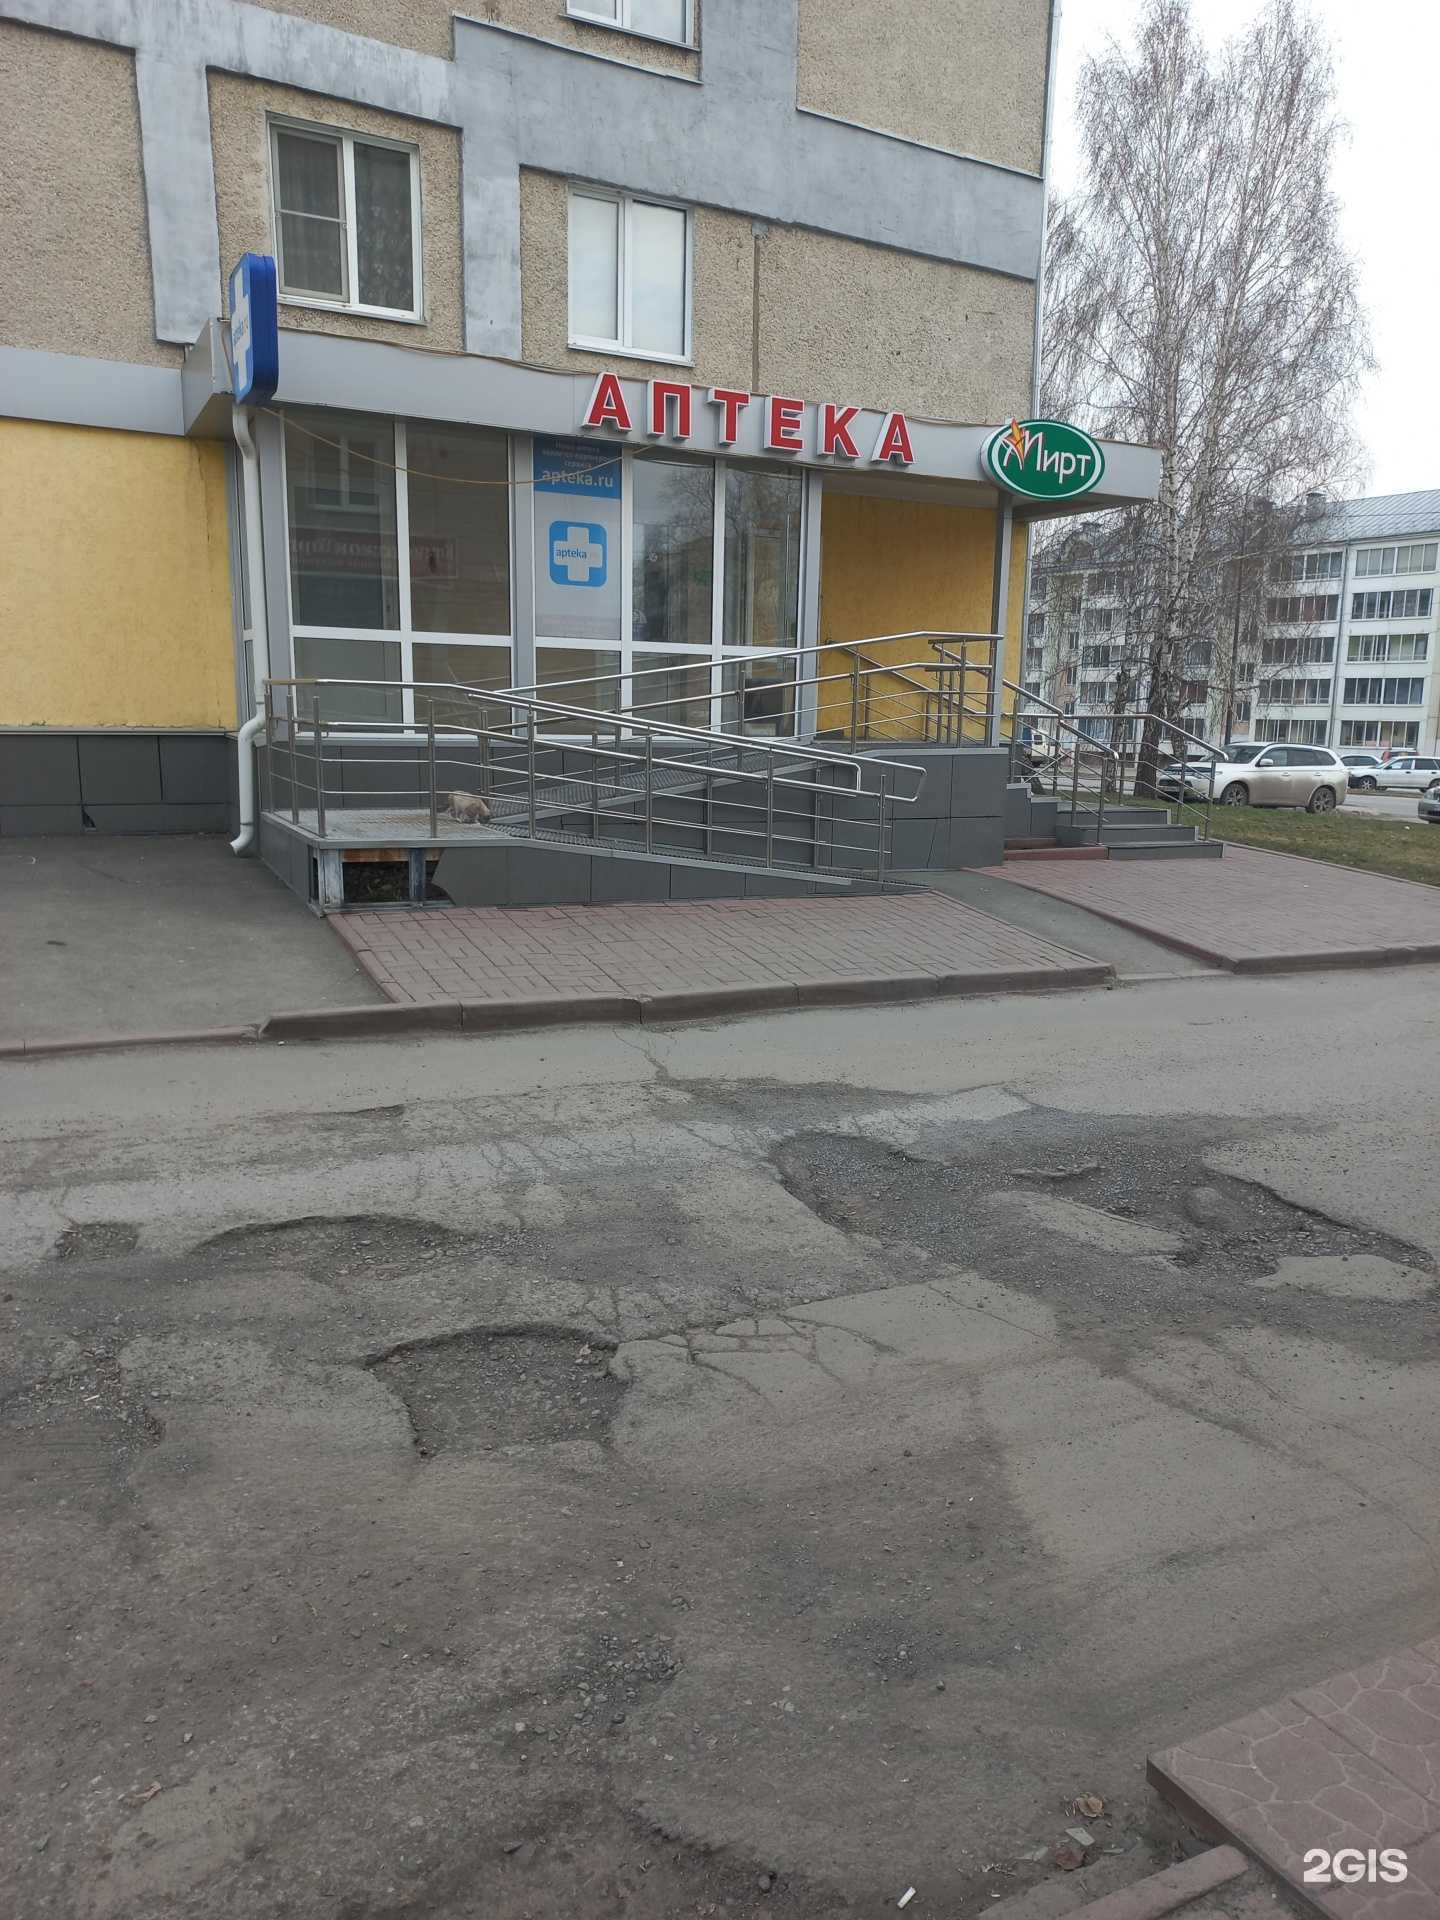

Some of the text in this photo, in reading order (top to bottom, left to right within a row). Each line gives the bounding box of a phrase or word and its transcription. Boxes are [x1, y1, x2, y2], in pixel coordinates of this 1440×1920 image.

[583, 372, 915, 464] АПТЕКА
[542, 469, 614, 488] apteka.ru
[1001, 428, 1091, 484] Мирт
